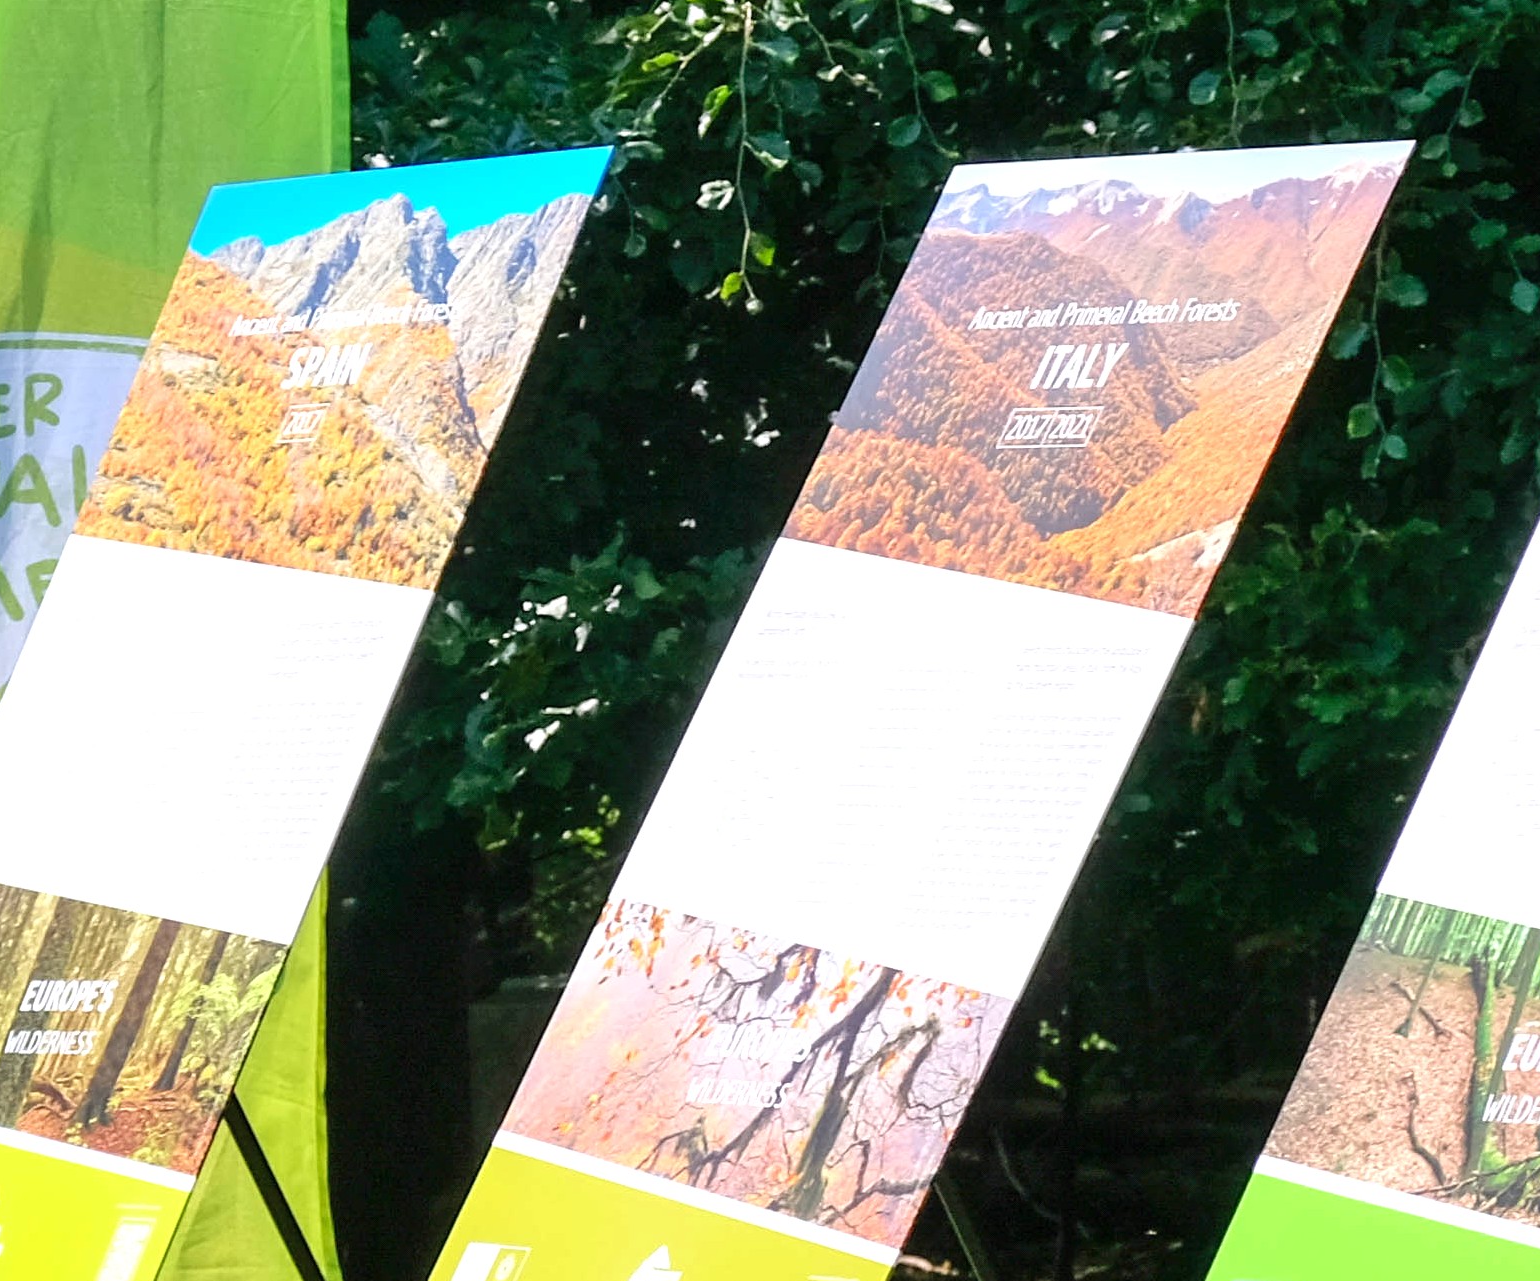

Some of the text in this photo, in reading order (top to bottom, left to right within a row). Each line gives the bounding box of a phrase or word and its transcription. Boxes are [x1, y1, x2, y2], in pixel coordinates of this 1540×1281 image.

[411, 298, 463, 323] Fores
[968, 297, 1241, 330] Ancient and Primeval Beech Forests
[280, 342, 373, 390] SPAIN
[1030, 343, 1130, 389] ITALY
[284, 409, 323, 435] 2017
[1005, 413, 1094, 440] 2017 2021
[19, 979, 119, 1013] EUROPE'S
[4, 1030, 98, 1056] WILDERNESS
[686, 1077, 792, 1108] WILDERNESS
